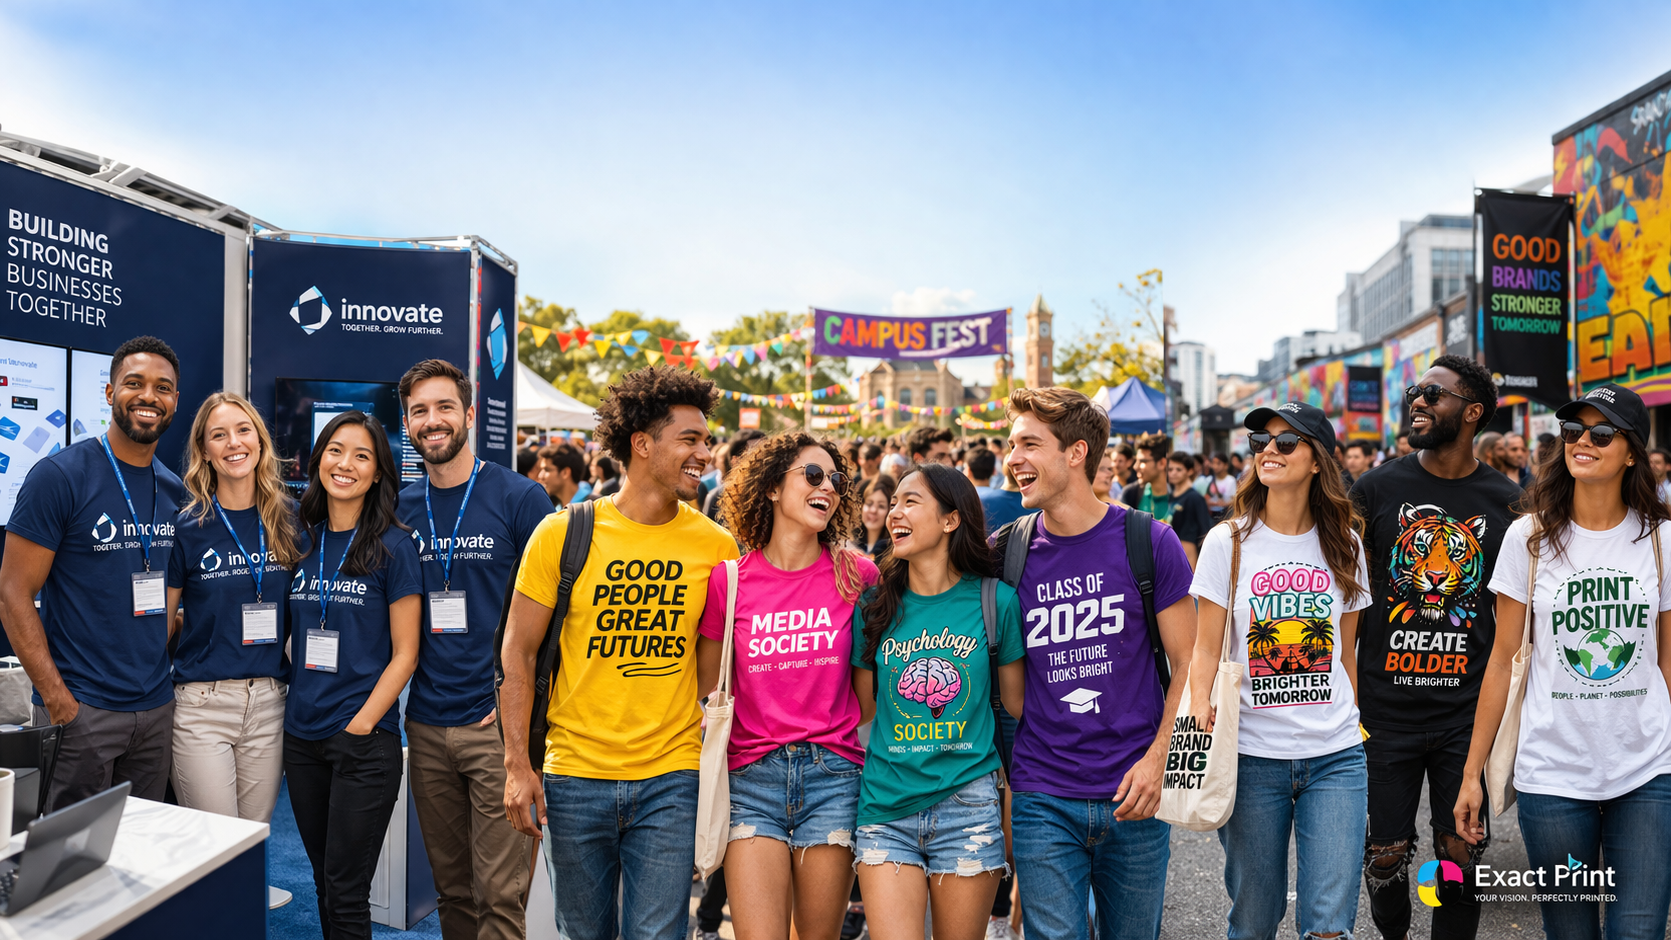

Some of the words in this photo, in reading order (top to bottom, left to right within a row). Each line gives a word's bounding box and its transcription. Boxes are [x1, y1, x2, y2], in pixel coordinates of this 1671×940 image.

[8, 208, 109, 254] BUILDING
[7, 236, 113, 280] STRONGER
[1492, 233, 1561, 263] GOOD
[7, 262, 123, 307] BUSINESSES
[1492, 265, 1561, 292] BRANDS
[6, 290, 107, 327] TOGETHER
[341, 298, 443, 323] innovate
[1491, 293, 1562, 315] STRONGER
[341, 323, 382, 333] TOGETHER.
[383, 325, 407, 334] GROW
[407, 326, 444, 335] FURTHER.
[823, 315, 926, 350] CAMPUS
[931, 317, 992, 349] FEST
[1491, 316, 1562, 334] TOMORROW
[605, 559, 683, 581] GOOD
[592, 583, 688, 606] PEOPLE
[1037, 577, 1083, 603] CLASS
[1086, 572, 1104, 594] OF
[1251, 569, 1330, 597] GOOD
[1567, 577, 1634, 605] PRINT
[1248, 592, 1334, 621] VIBES
[596, 609, 685, 631] GREAT
[751, 607, 832, 635] MEDIA
[1026, 594, 1125, 648] 2025
[1552, 604, 1650, 635] POSITIVE
[586, 635, 687, 659] FUTURES
[748, 630, 839, 658] SOCIETY
[882, 626, 978, 665] Psychology
[1389, 629, 1468, 652] CREATE
[748, 663, 772, 674] CREATE
[778, 659, 808, 671] CAPTURE
[1047, 652, 1067, 667] THE
[1069, 644, 1108, 662] FUTURE
[1384, 652, 1468, 674] BOLDER
[1047, 666, 1077, 683] LOOKS
[1079, 661, 1113, 679] BRIGHT
[1251, 674, 1330, 691] BRIGHTER
[1393, 675, 1413, 686] LIVE
[1414, 676, 1460, 687] BRIGHTER
[1251, 688, 1332, 706] TOMORROW
[1551, 691, 1574, 700] PEOPLE
[1580, 692, 1604, 700] PLANET
[894, 721, 967, 742] SOCIETY
[1173, 715, 1205, 733] SMAL
[911, 744, 934, 753] IMPACT
[1169, 734, 1213, 751] BRAND
[1165, 751, 1207, 771] BIG
[1163, 772, 1205, 789] IMPACT
